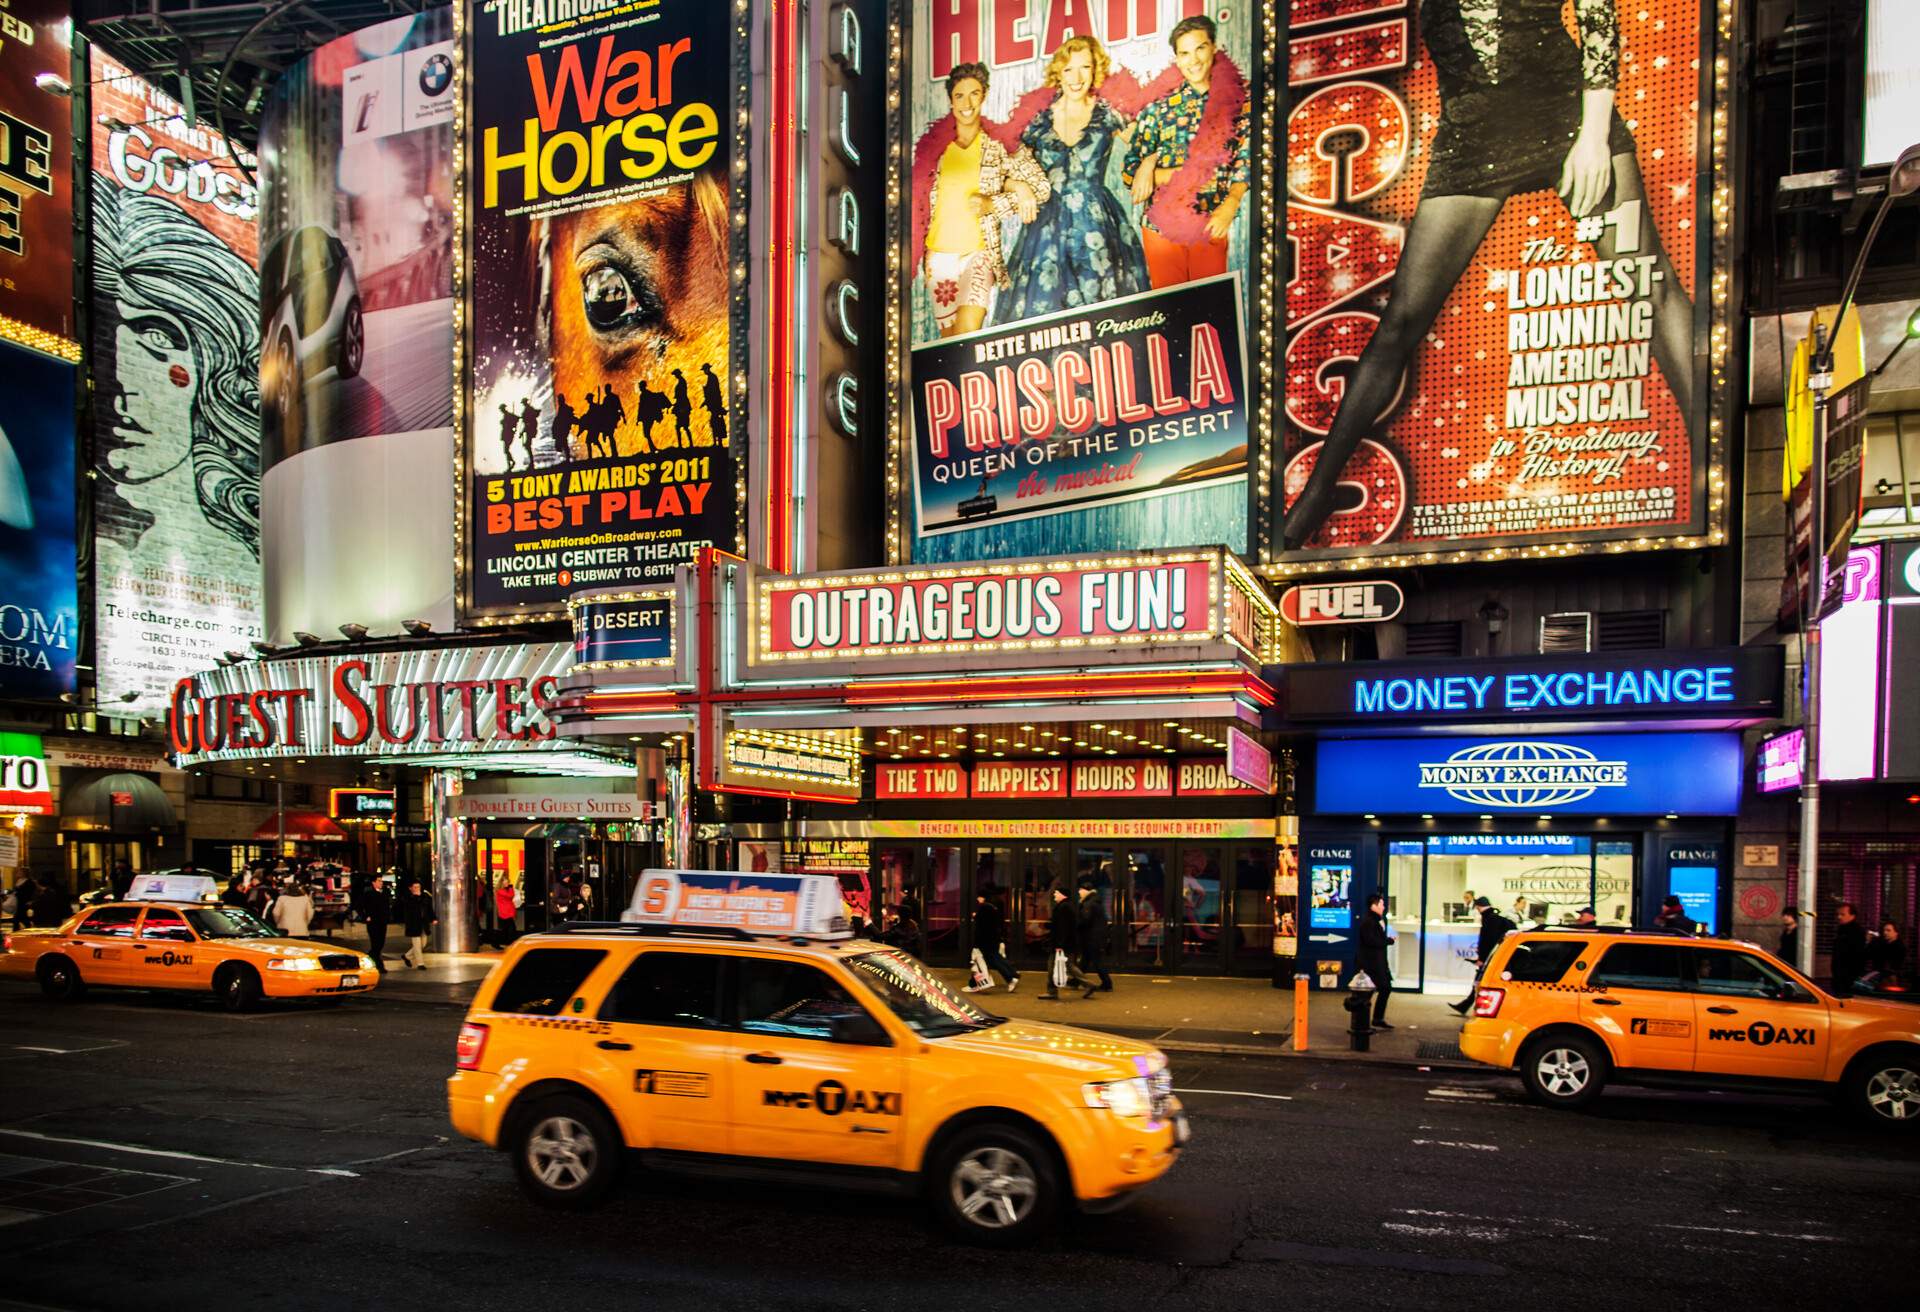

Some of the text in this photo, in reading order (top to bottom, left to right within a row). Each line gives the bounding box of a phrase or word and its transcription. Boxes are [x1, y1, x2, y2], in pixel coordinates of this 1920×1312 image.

[613, 5, 633, 15] York
[526, 35, 691, 133] War
[484, 102, 719, 208] Horse
[1521, 200, 1641, 264] The #1
[1508, 255, 1664, 309] LONGEST-
[975, 310, 1166, 363] BETTE MIDLER Presents
[1508, 301, 1654, 352] RUNNING
[1508, 342, 1650, 387] AMERICAN
[924, 323, 1235, 459] PRISCILLA
[1505, 380, 1649, 429] MUSICAL
[932, 410, 1234, 483] QUEEN OF THE DESERT
[1489, 421, 1663, 459] in Broadway
[487, 480, 505, 502] 5
[510, 473, 563, 500] TONY
[660, 456, 710, 483] 2011
[1016, 453, 1144, 499] the musical
[1516, 452, 1629, 485] History!
[487, 482, 712, 534] BEST PLAY
[1413, 486, 1674, 517] TELECHARGE.COM/CHICAGO
[1494, 519, 1537, 531] THEATRE
[1616, 509, 1674, 522] BROADWAY
[515, 528, 683, 552] www.WarHorseOnBroadway.com
[487, 553, 557, 574] LINCOLN
[561, 547, 629, 567] CENTER
[501, 574, 532, 589] TAKE
[533, 572, 557, 587] THE
[572, 567, 622, 582] SUBWAY
[624, 566, 642, 579] TO
[644, 563, 675, 577] 66TH
[593, 610, 664, 630] DESERT
[790, 575, 1062, 649] OUTRAGEOUS
[1080, 568, 1187, 634] FUN!
[1298, 585, 1383, 620] FUEL
[141, 631, 181, 646] CIRCLE
[185, 638, 197, 647] IN
[1355, 666, 1735, 713] MONEY EXCHANGE
[169, 660, 557, 755] GUEST SUITES
[105, 755, 128, 763] FOR
[130, 757, 160, 765] RENT
[1420, 764, 1628, 784] MONEY EXCHANGE
[886, 769, 918, 793] THE
[924, 769, 958, 793] TWO
[977, 767, 1061, 793] HAPPIEST
[1076, 766, 1136, 792] HOURS
[1143, 765, 1169, 790] ON
[540, 797, 584, 814] GUEST
[586, 798, 632, 814] SUITES
[920, 823, 959, 834] BENEATH
[962, 823, 978, 834] ALL
[983, 823, 1004, 834] THAT
[1009, 823, 1035, 834] GLITZ
[1039, 823, 1066, 834] BEATS
[1080, 823, 1109, 834] GREAT
[1113, 823, 1129, 834] BIG
[1134, 823, 1183, 834] SEQUINED
[1186, 823, 1222, 834] HEART!
[809, 841, 832, 853] WHAT
[1310, 848, 1352, 859] CHANGE
[1670, 850, 1719, 860] CHANGE
[643, 878, 672, 913] S
[1503, 878, 1525, 890] THE
[1530, 880, 1582, 890] CHANGE
[1709, 1028, 1747, 1042] NYC
[1747, 1020, 1816, 1046] TAXI
[762, 1079, 904, 1117] NYC TAXI
